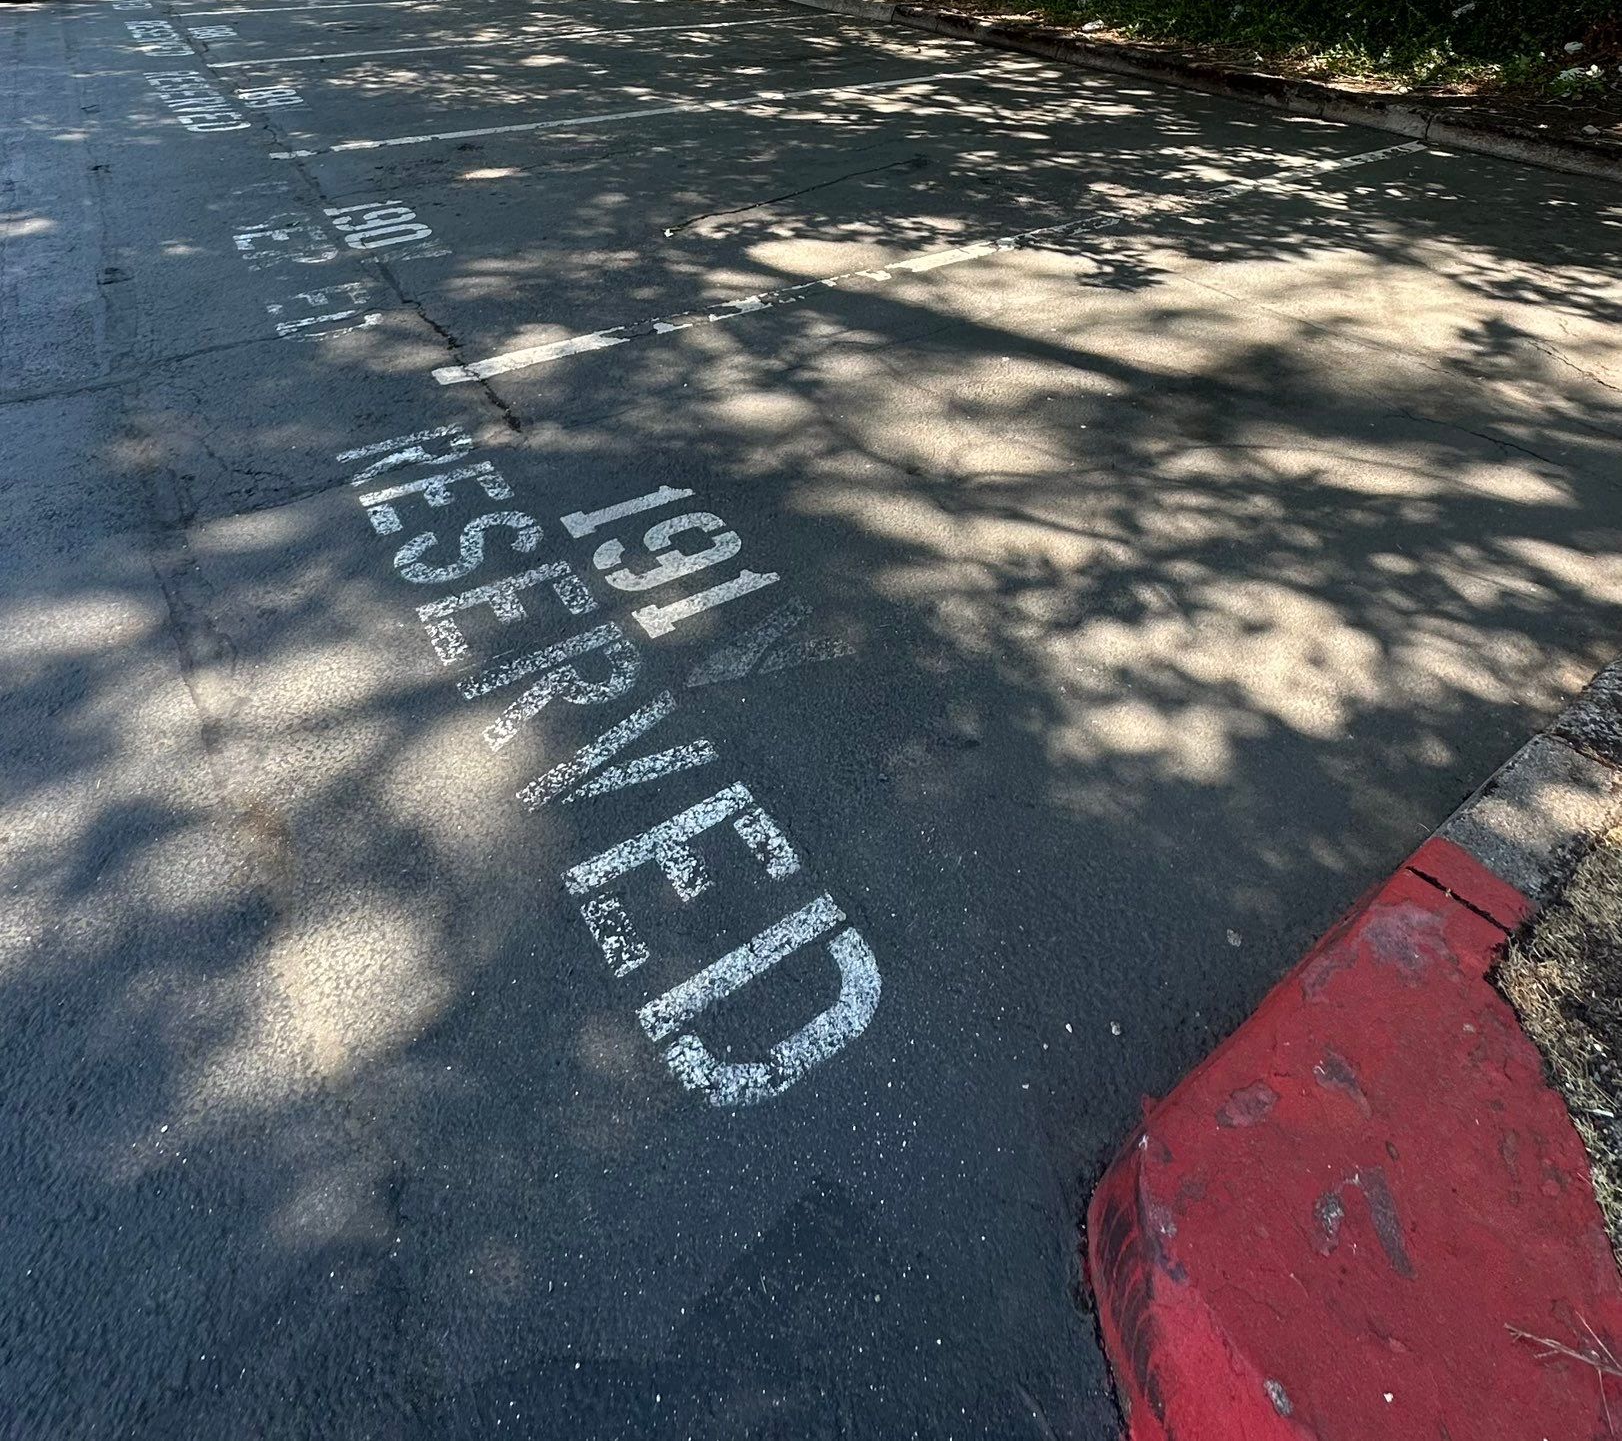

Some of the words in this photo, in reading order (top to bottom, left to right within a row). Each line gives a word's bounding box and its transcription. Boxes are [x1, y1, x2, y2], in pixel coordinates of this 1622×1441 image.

[143, 70, 251, 132] RESERVED
[234, 85, 304, 109] 189
[323, 200, 432, 249] 190
[560, 485, 781, 640] 191
[336, 423, 882, 1108] RESERVED
